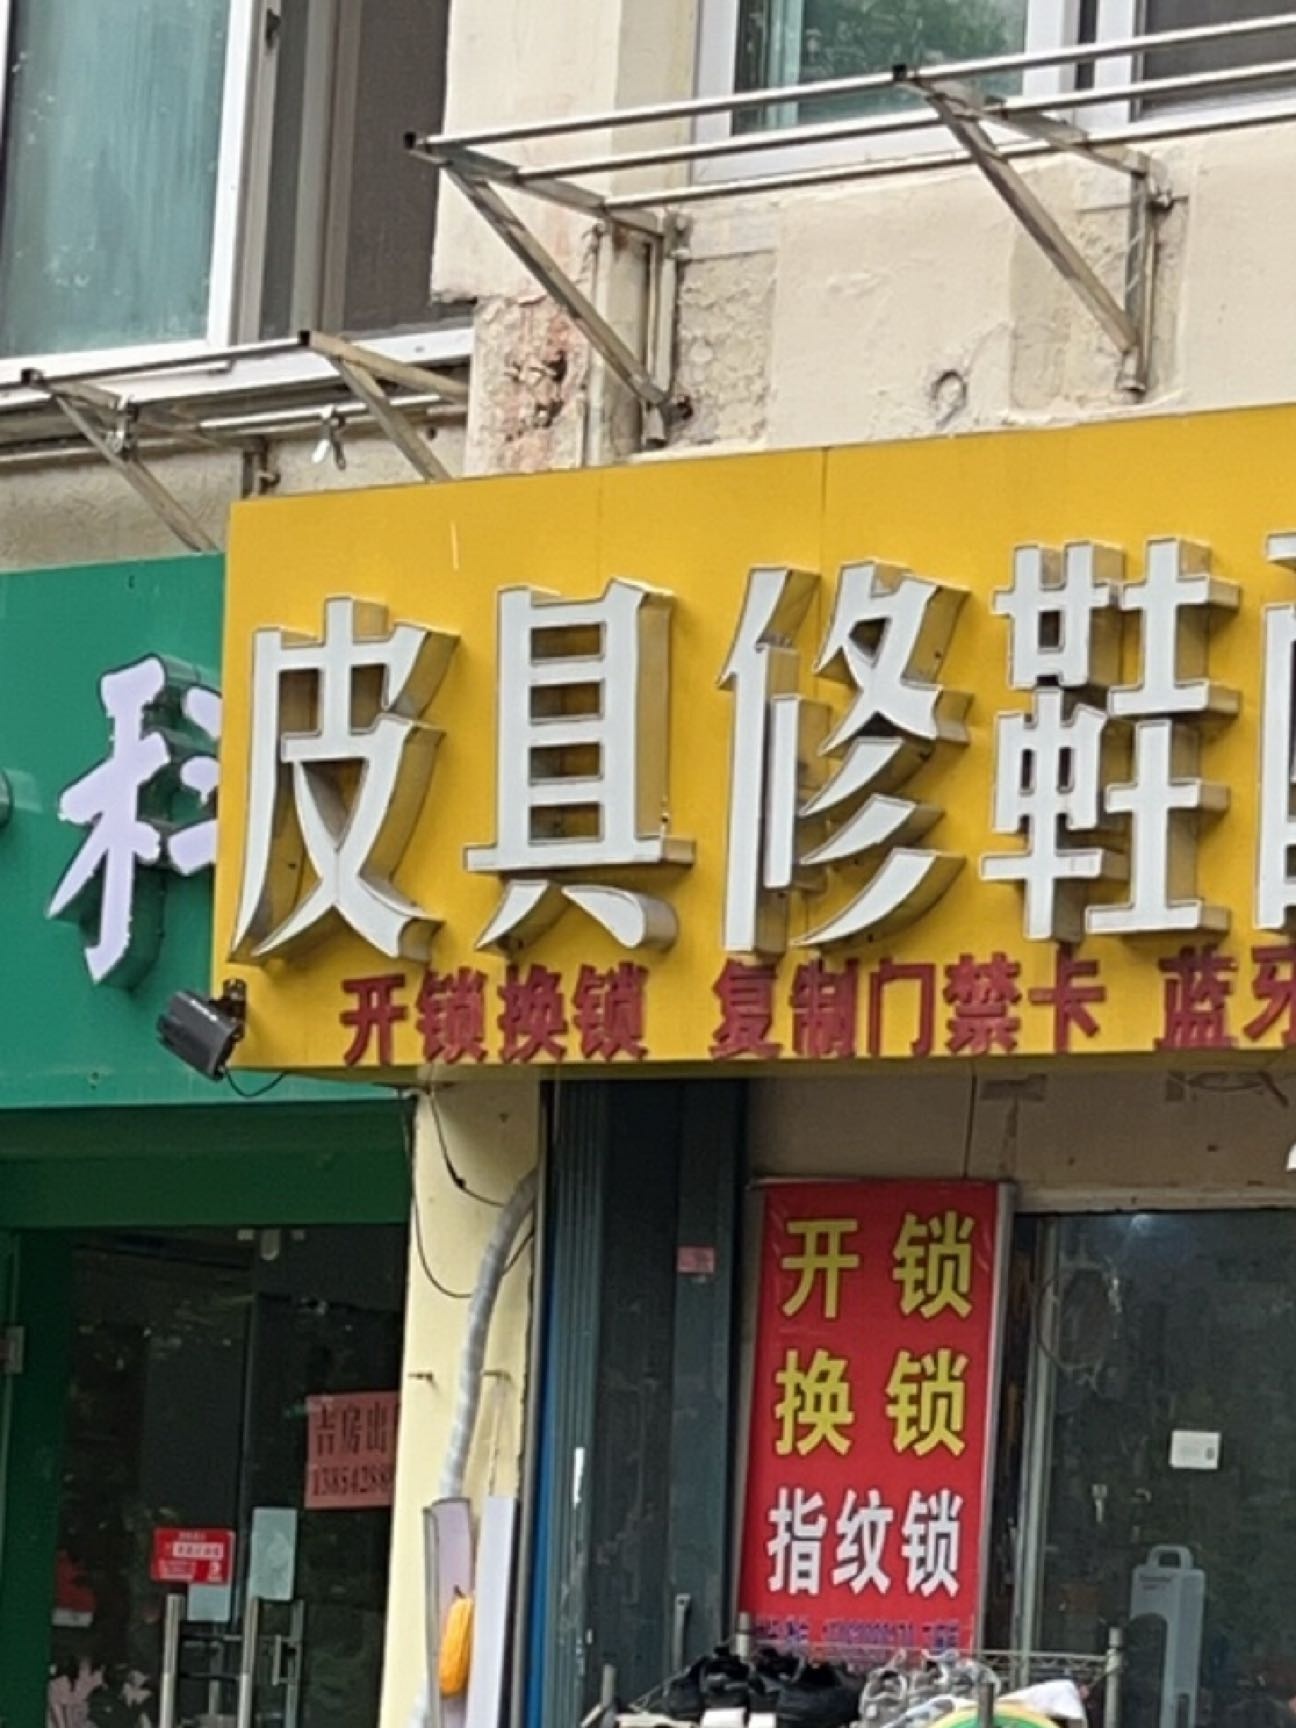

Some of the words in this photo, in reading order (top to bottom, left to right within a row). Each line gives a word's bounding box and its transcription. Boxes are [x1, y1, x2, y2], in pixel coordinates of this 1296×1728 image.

[340, 961, 649, 1065] 开锁换锁
[711, 943, 1105, 1061] 复制门禁卡
[781, 1210, 973, 1320] 开锁
[316, 1402, 398, 1457] 吉房出
[775, 1347, 967, 1456] 换锁
[767, 1487, 965, 1598] 指纹锁
